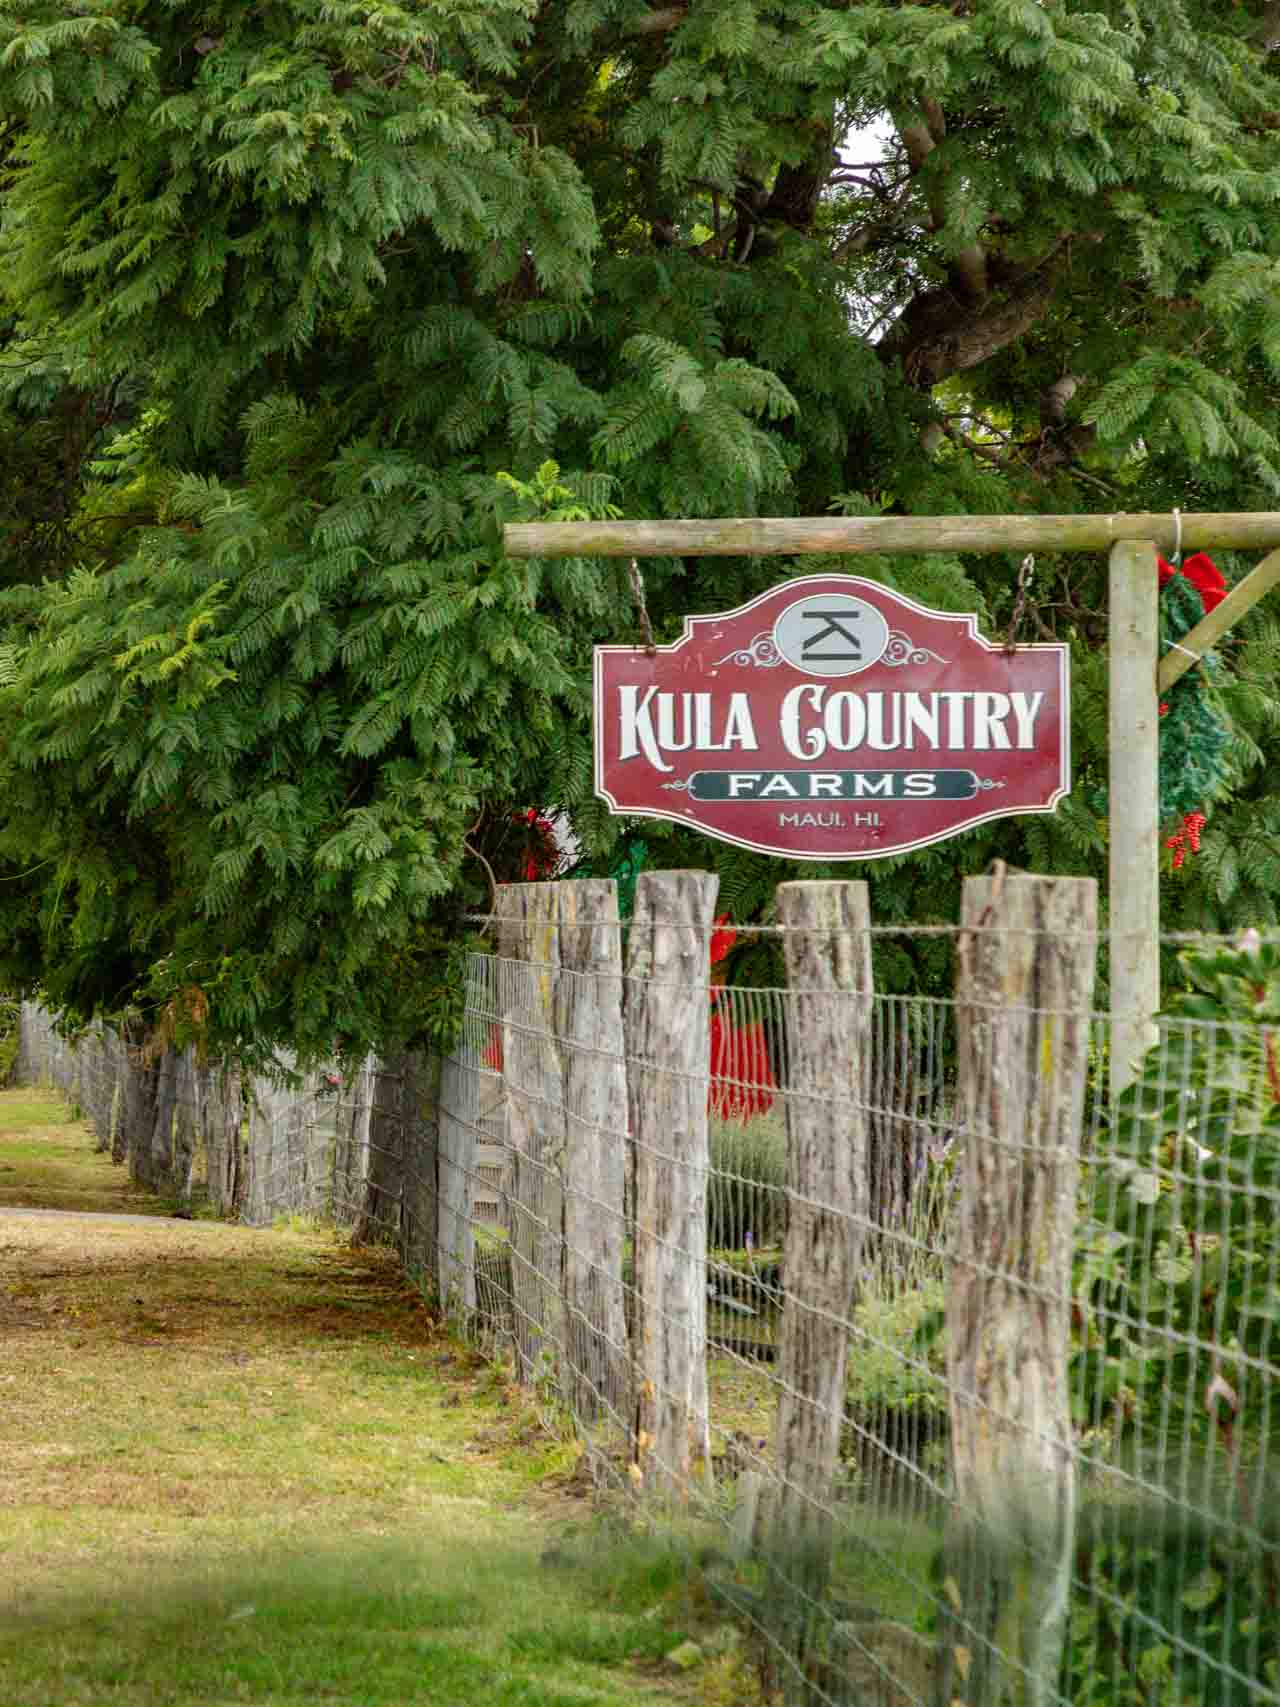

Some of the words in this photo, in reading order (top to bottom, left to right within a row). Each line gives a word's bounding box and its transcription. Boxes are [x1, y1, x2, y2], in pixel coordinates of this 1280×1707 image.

[618, 684, 759, 772] KULA
[780, 683, 1045, 761] COUNTRY
[727, 773, 938, 798] FARMS
